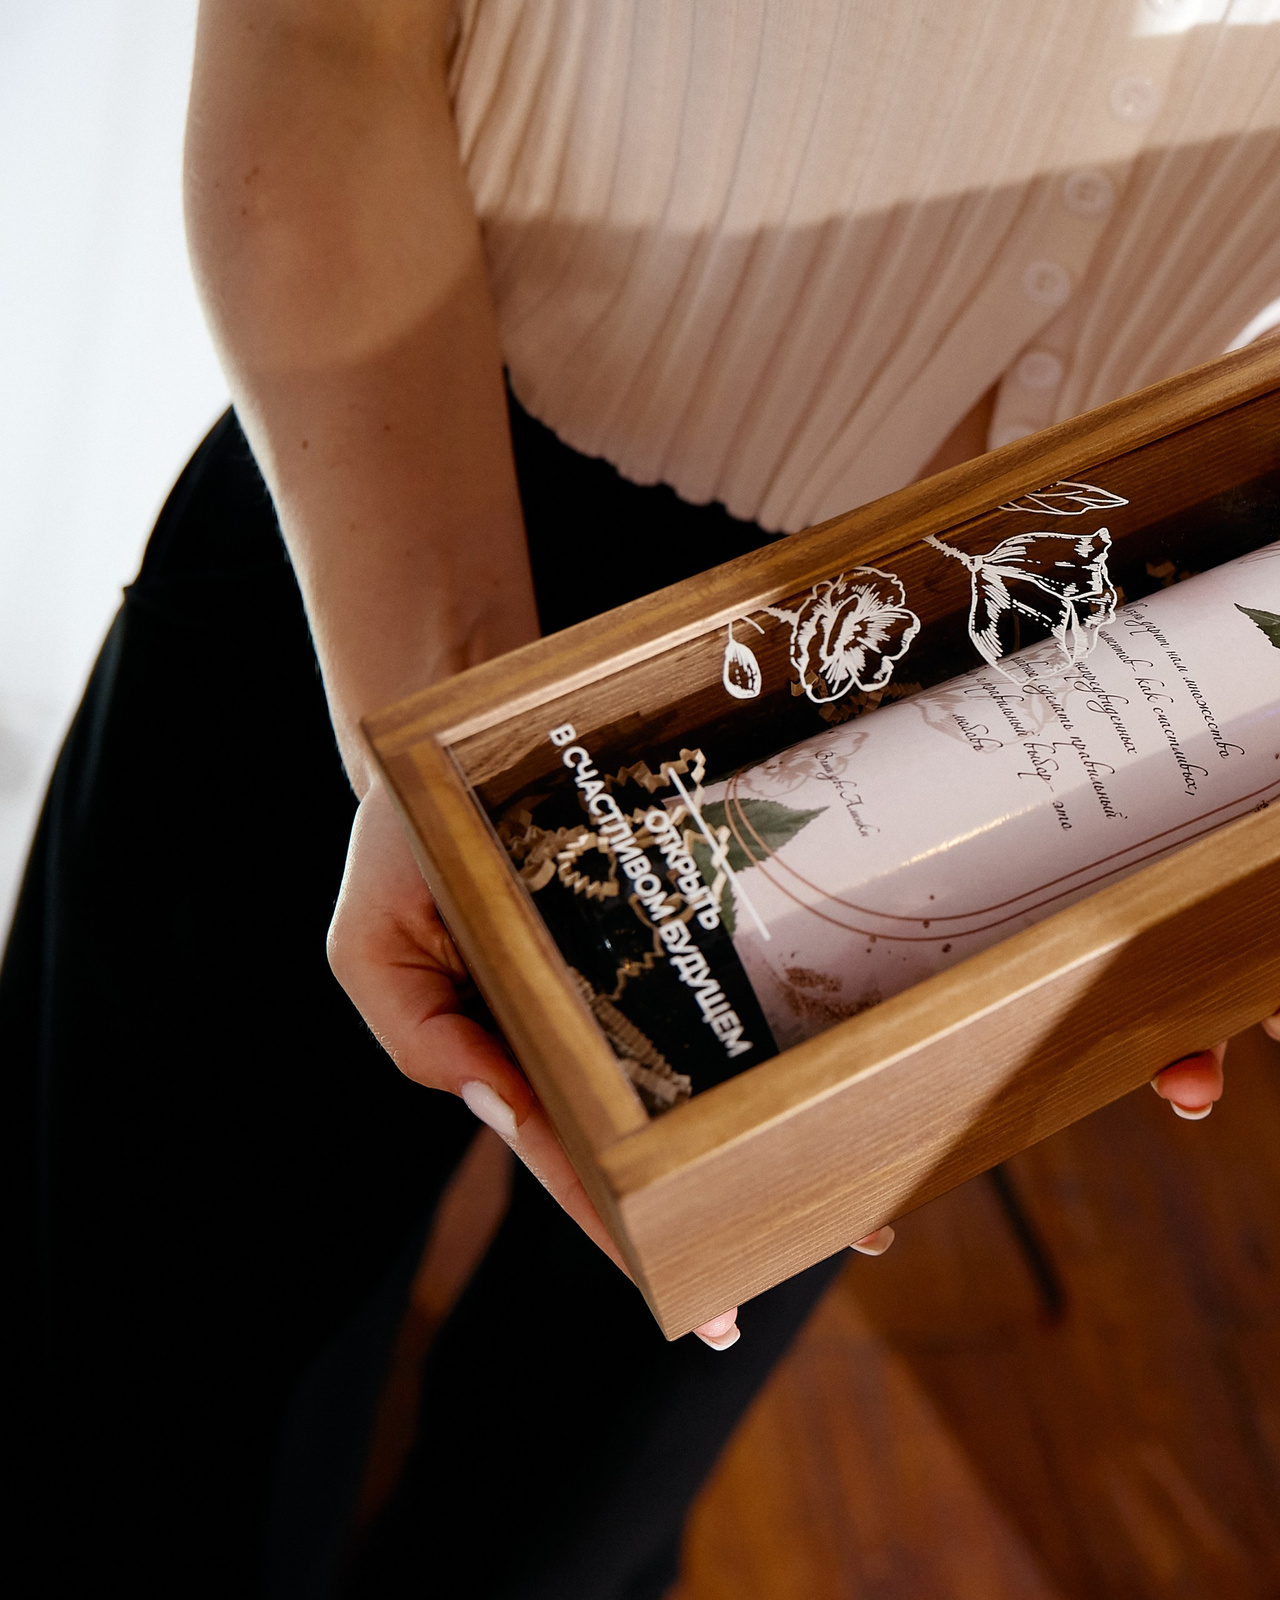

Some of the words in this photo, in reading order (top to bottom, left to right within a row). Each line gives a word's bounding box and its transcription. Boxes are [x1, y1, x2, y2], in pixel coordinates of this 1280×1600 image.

[548, 723, 577, 748] В
[952, 713, 1005, 753] любовь
[1062, 661, 1138, 756] непредвиденных
[1134, 677, 1175, 704] как
[1166, 650, 1189, 674] нам
[1182, 676, 1246, 759] множество
[963, 682, 1041, 738] правильный
[1051, 800, 1073, 832] это
[1021, 684, 1075, 732] сделать
[1051, 735, 1128, 820] правильный
[1152, 706, 1209, 796] счастливых,
[562, 745, 676, 922] СЧАСТЛИВОМ
[644, 809, 721, 931] ОТКРЫТЬ
[657, 918, 754, 1059] БУДУЩЕМ
